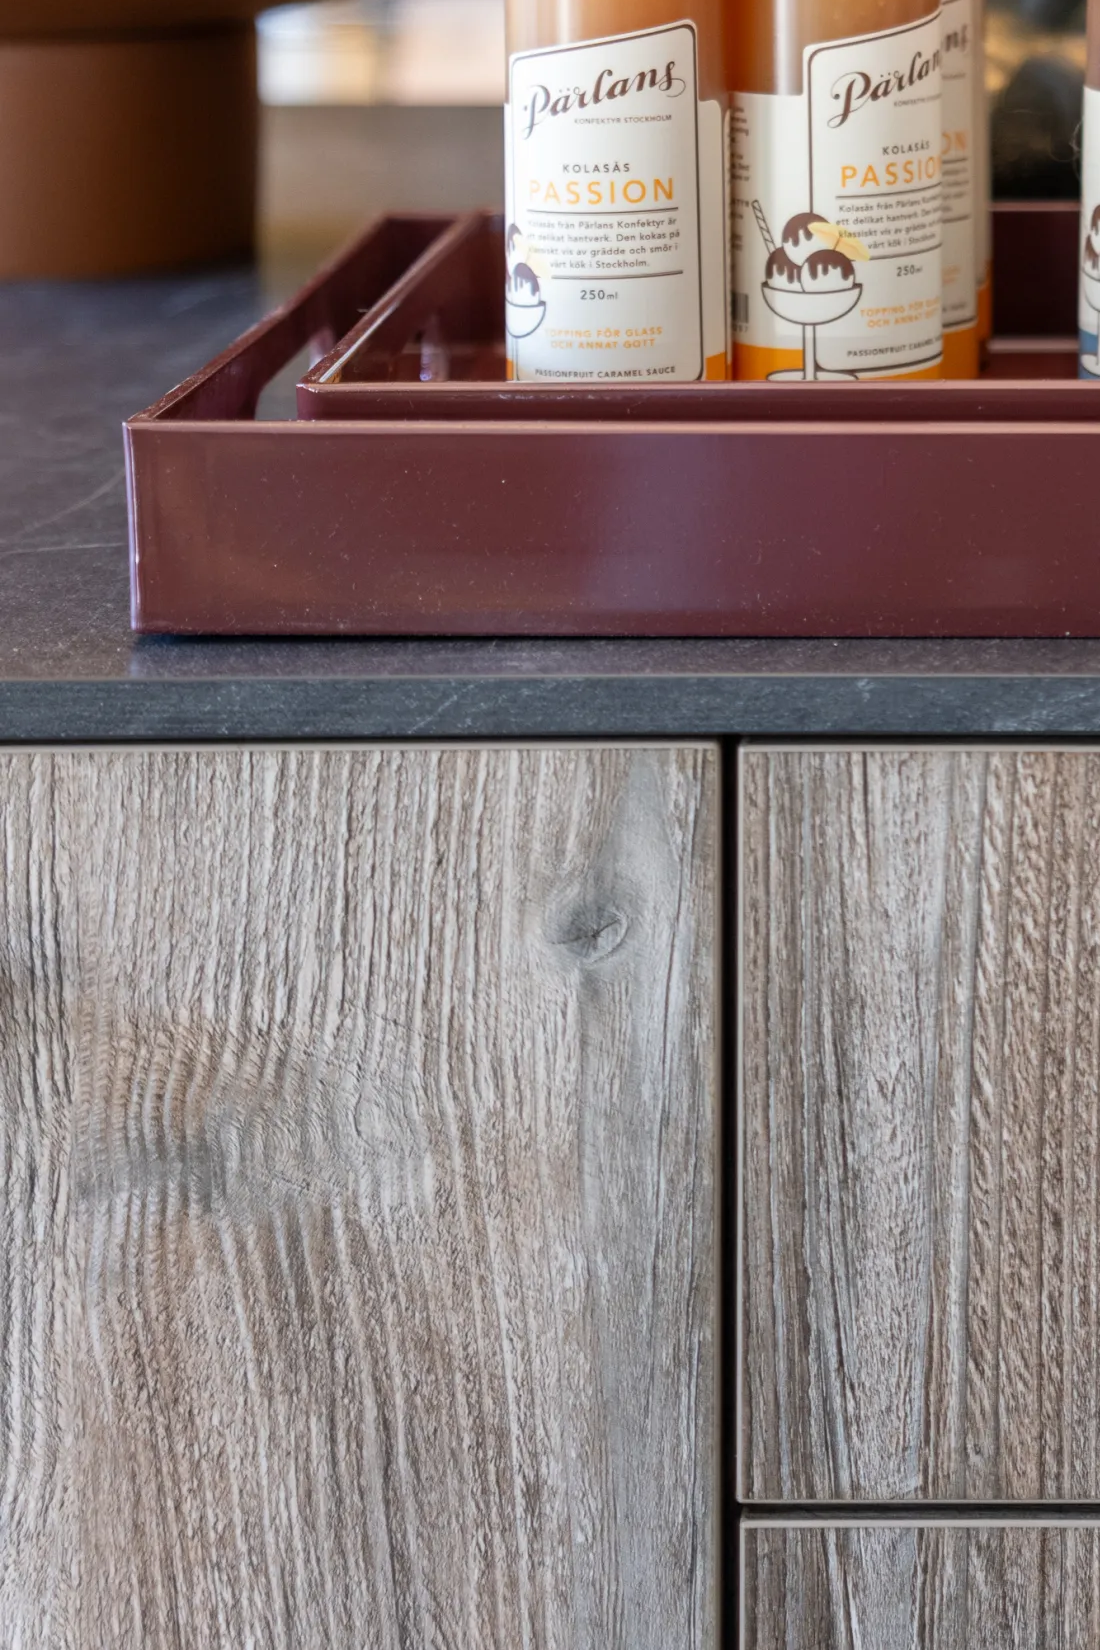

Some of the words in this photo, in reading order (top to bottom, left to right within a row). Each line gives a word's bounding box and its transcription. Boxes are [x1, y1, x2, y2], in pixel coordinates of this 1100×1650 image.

[827, 48, 941, 129] Pärlan
[522, 60, 687, 140] Pärlans
[624, 114, 672, 124] STOCKHOLM
[562, 160, 631, 174] KOLASÅS
[528, 178, 674, 205] PASSION
[838, 203, 874, 213] Kolasås
[877, 200, 894, 210] från
[578, 220, 613, 230] Pärlans
[617, 219, 665, 231] Konfektyr
[835, 217, 849, 226] ett
[852, 214, 885, 226] delikat
[616, 233, 636, 242] Den
[639, 231, 667, 241] kokas
[669, 230, 680, 241] på
[868, 240, 885, 250] vårt
[888, 238, 902, 248] kök
[576, 248, 587, 256] av
[590, 246, 626, 258] grädde
[629, 246, 646, 256] och
[650, 244, 672, 254] smör
[569, 259, 586, 269] kök
[595, 259, 651, 269] Stockholm.
[867, 318, 890, 329] OCH
[625, 326, 663, 338] GLASS
[578, 340, 618, 349] ANNAT
[623, 338, 656, 349] GOTT
[846, 344, 907, 358] PASSIONFRUIT
[534, 367, 594, 379] PASSIONFRUIT
[597, 368, 643, 379] CARAMEL
[647, 366, 676, 377] SAUCE
